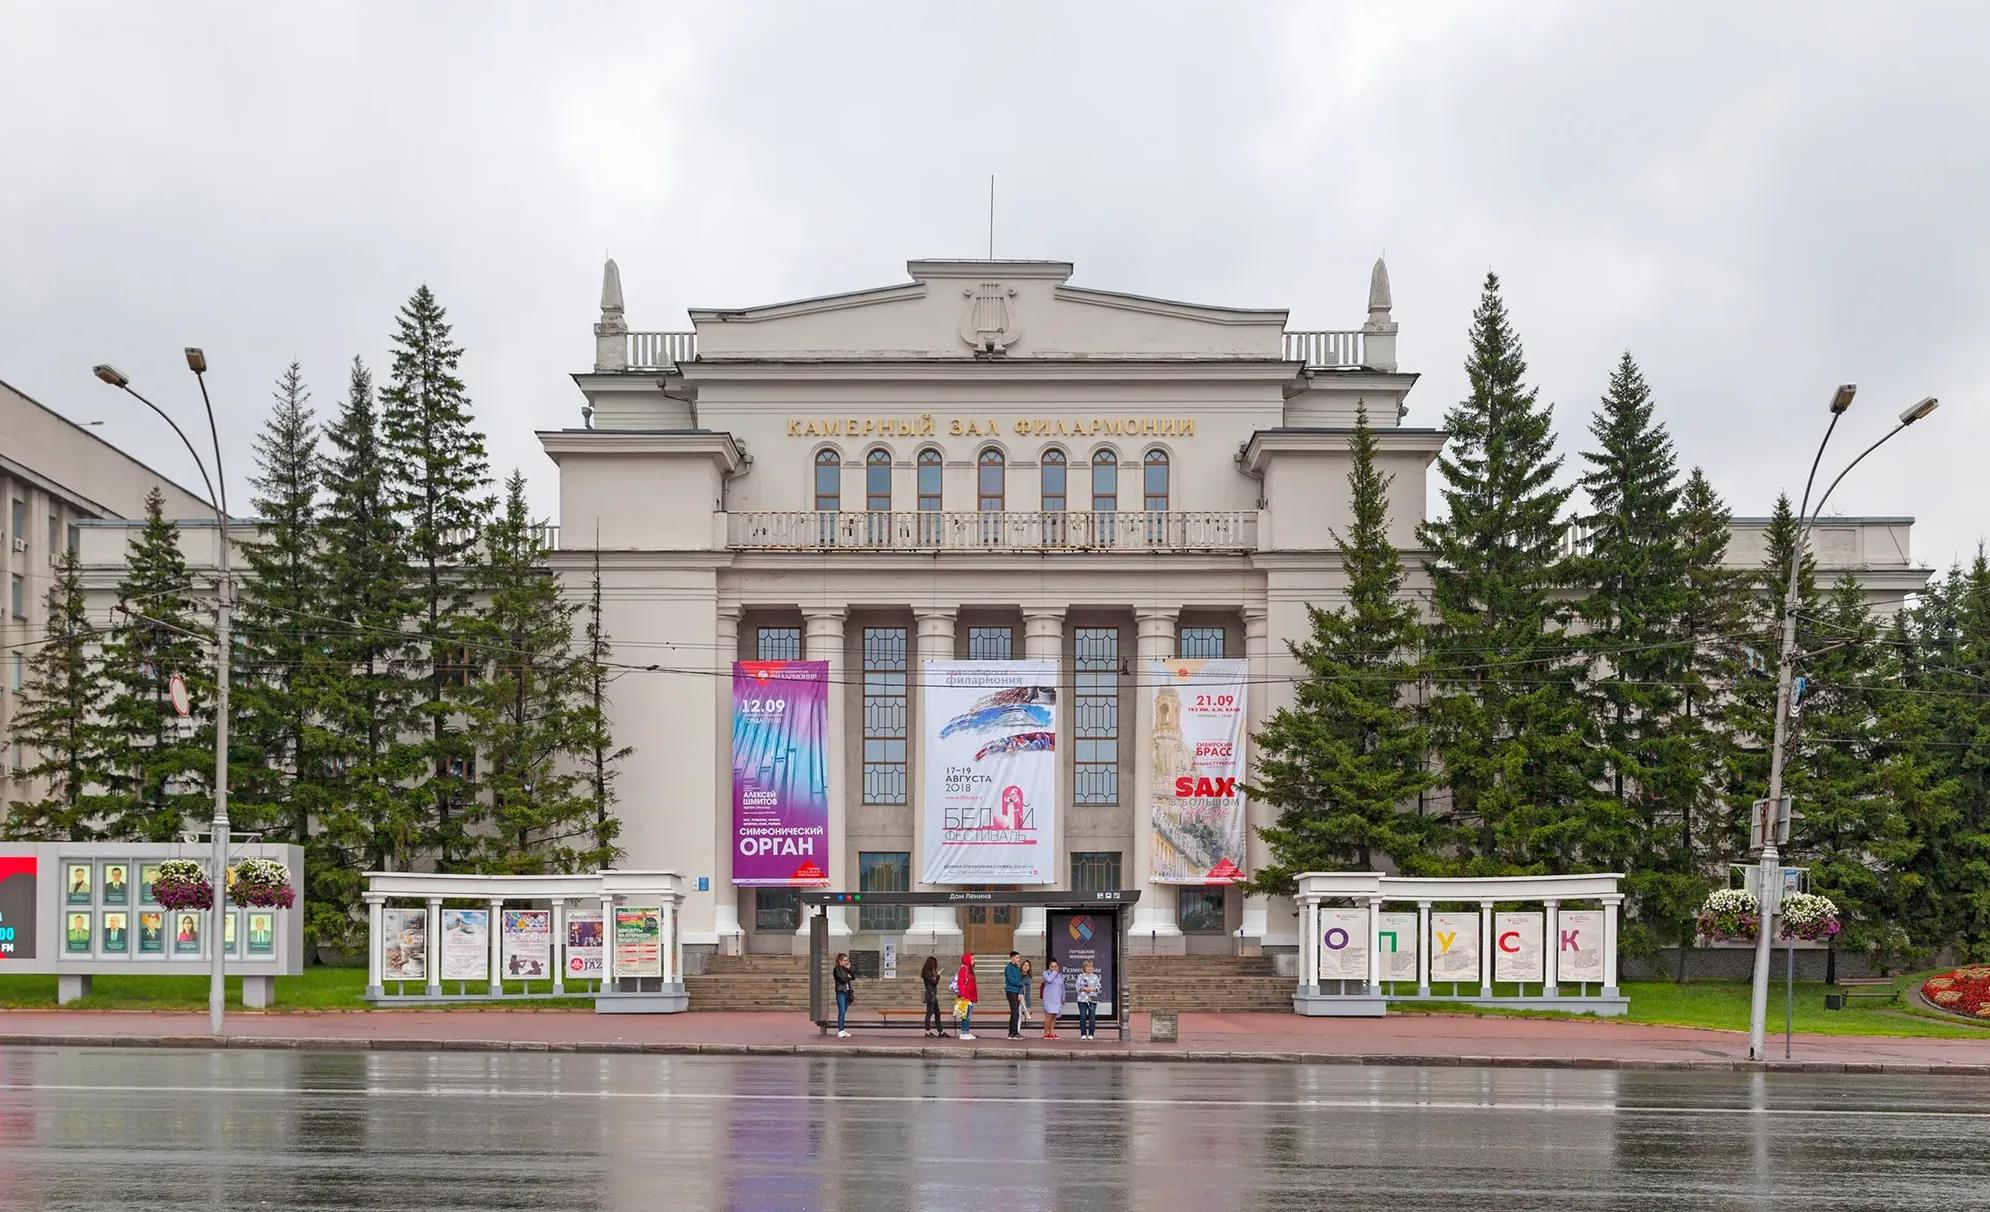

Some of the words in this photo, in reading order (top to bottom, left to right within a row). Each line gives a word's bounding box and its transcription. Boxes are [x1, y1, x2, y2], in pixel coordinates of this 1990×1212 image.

[787, 413, 936, 437] КАМЕРНЫЙ
[949, 418, 1000, 437] ЗАЛ
[1013, 418, 1196, 437] ФИЛАРМОНИИ
[945, 676, 1023, 686] филармония
[1196, 695, 1234, 706] 21.09
[742, 699, 786, 713] 12.09
[1196, 747, 1233, 757] БРАСС
[945, 775, 993, 783] АВГУСТА
[945, 784, 972, 793] 2018
[1175, 776, 1236, 798] SAX
[743, 790, 777, 798] АЛЕКСЕЙ
[1182, 798, 1240, 807] БОЛЬШОМ
[739, 825, 824, 836] СИМФОНИЧЕСКИЙ
[945, 830, 1026, 843] ФЕСТИВАЛЬ
[739, 837, 814, 856] ОРГАН
[949, 892, 964, 901] Дом
[966, 892, 992, 900] Ленина
[2, 944, 14, 953] FM
